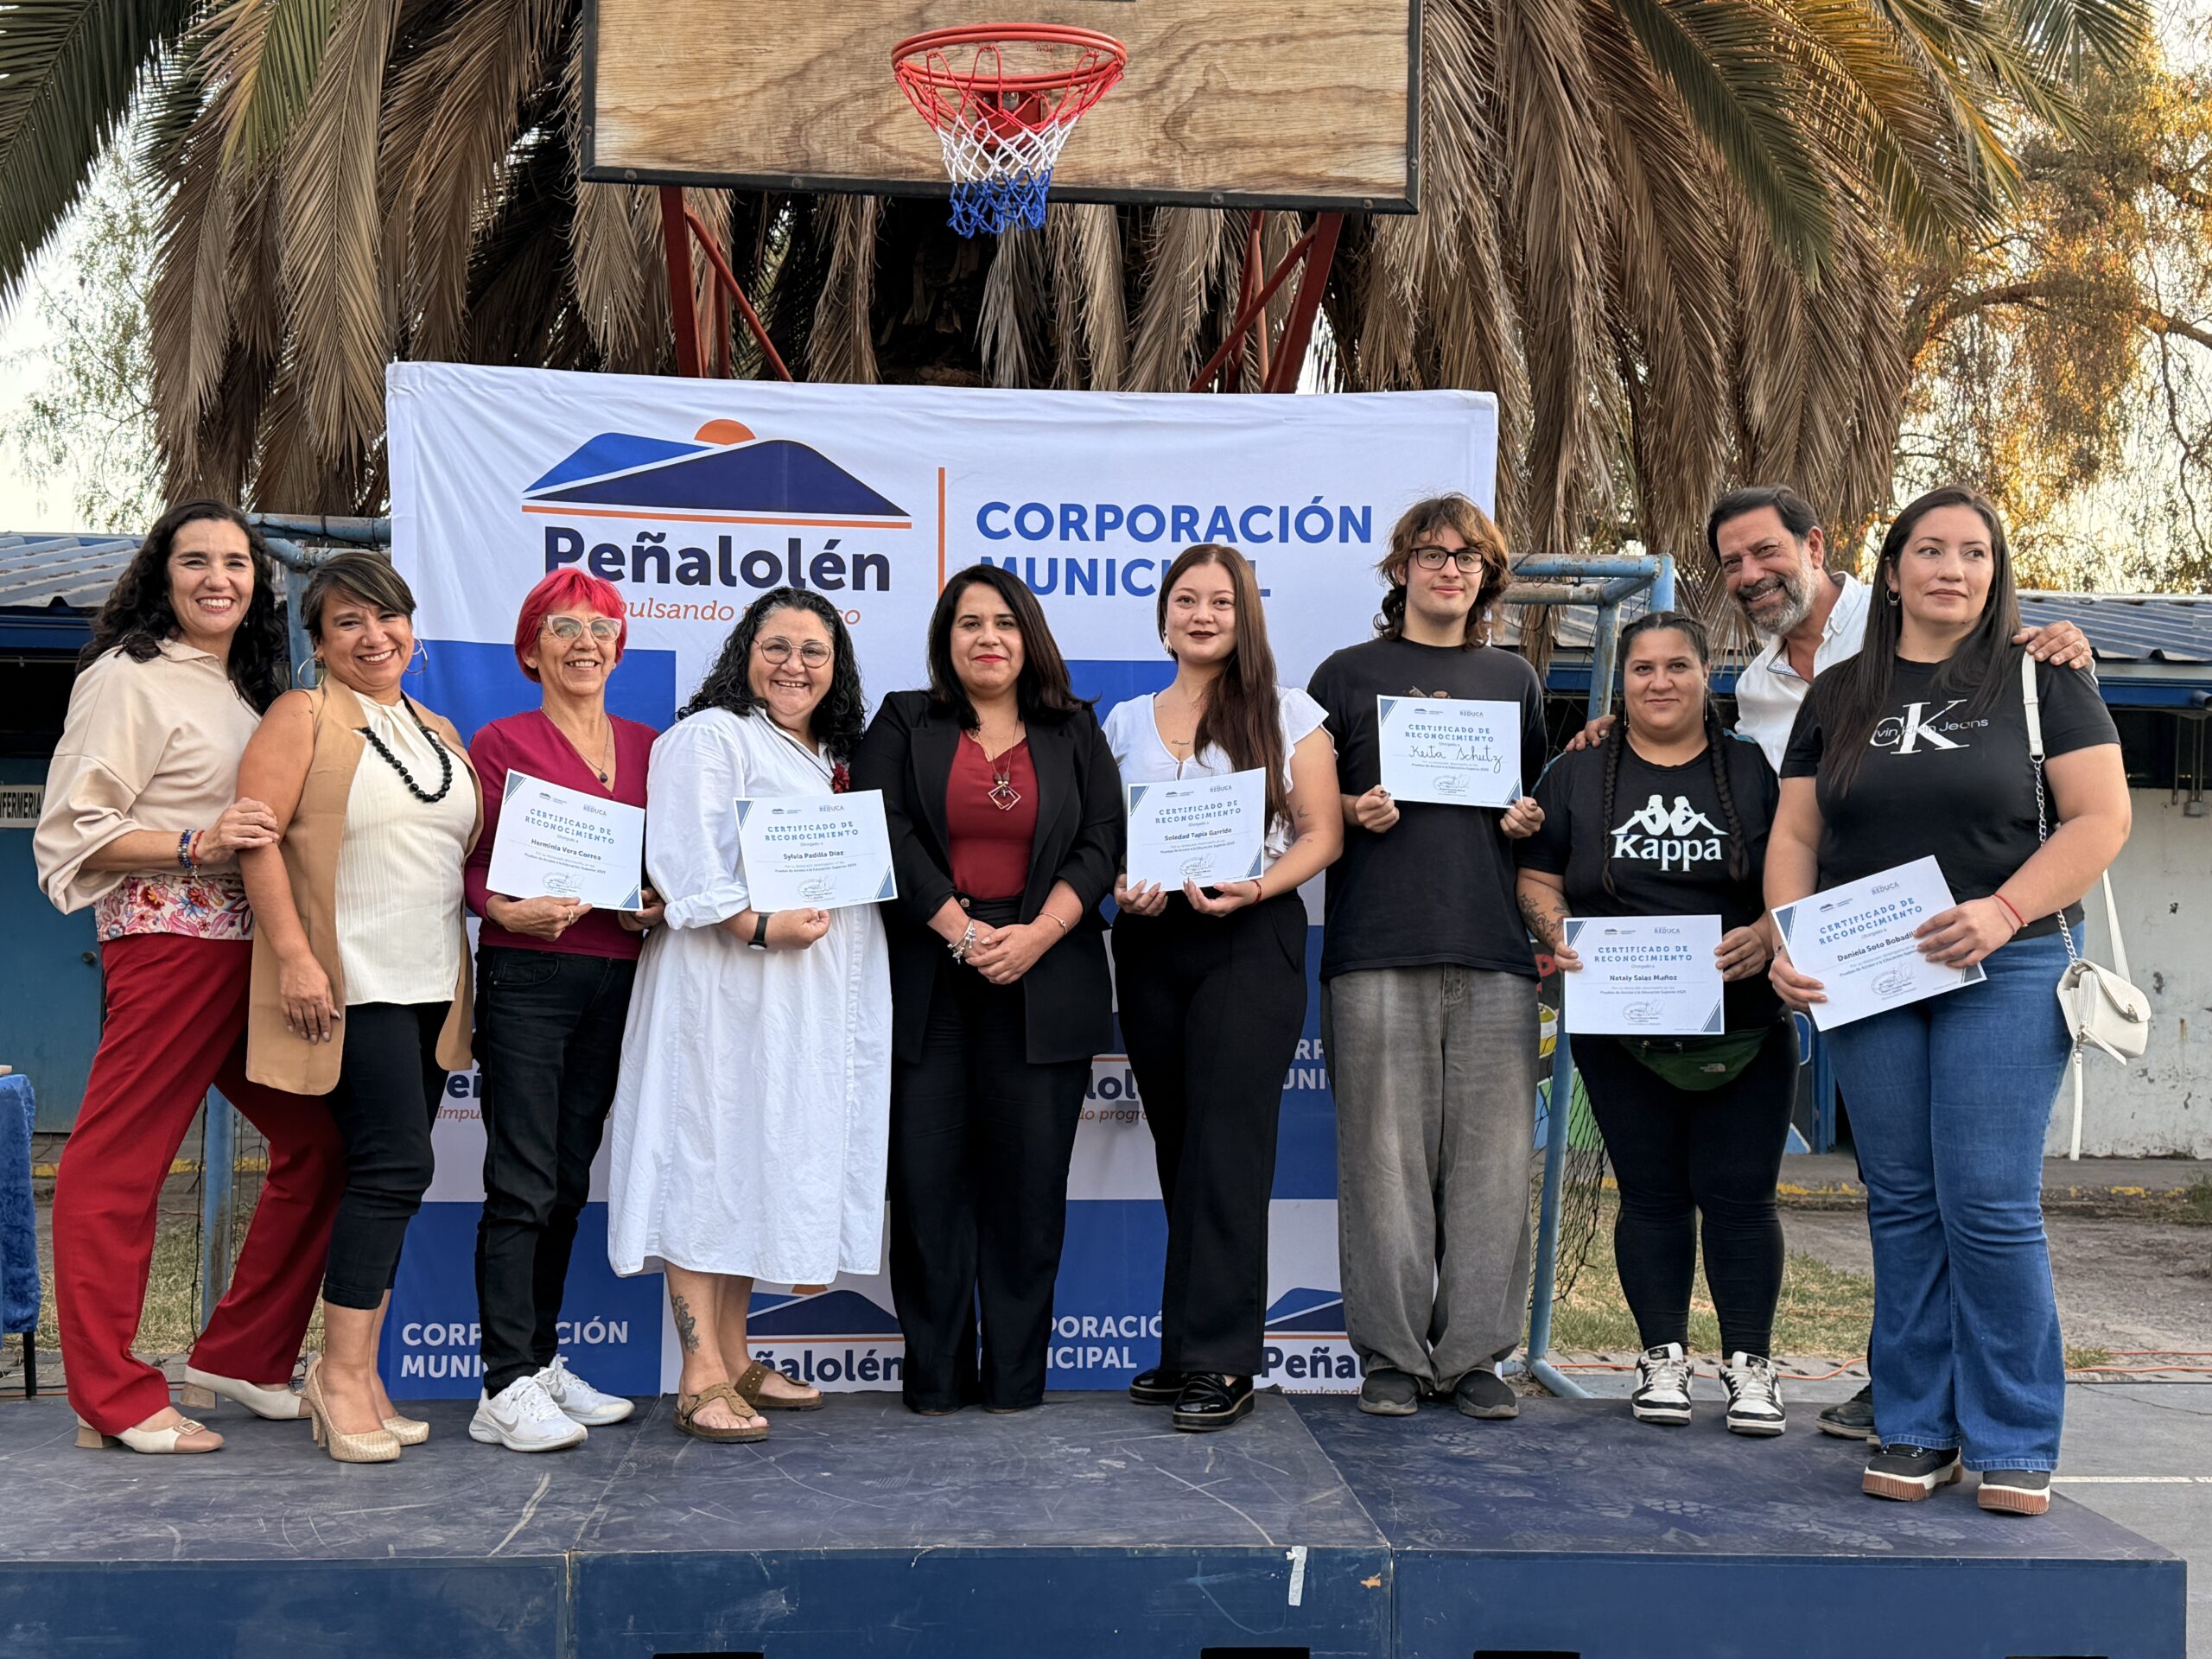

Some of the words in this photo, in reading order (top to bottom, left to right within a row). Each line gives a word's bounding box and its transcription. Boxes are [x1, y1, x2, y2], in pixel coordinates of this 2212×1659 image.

[402, 452, 628, 482] CORPCIÓN
[976, 496, 1372, 543] CORPORACIÓN
[545, 526, 890, 592] Peñalolén
[1405, 731, 1493, 741] RECONOCIMIENTO
[1408, 723, 1473, 733] CERTIFICADO
[1939, 719, 1989, 732] Jeans
[0, 791, 41, 819] FERMERIA
[1155, 807, 1241, 823] RECONOCIMIENTO
[1159, 802, 1222, 815] CERTIFICADO
[524, 816, 613, 843] RECONOCIMIENTO
[530, 808, 594, 830] CERTIFICADO
[599, 826, 611, 835] DE
[767, 823, 836, 832] CERTIFICADO
[1208, 827, 1231, 836] Garrido
[765, 829, 858, 841] RECONOCIMIENTO
[562, 846, 576, 855] Vera
[577, 850, 601, 860] Correa
[1612, 834, 1723, 872] Kappa
[1819, 906, 1921, 944] RECONOCIMIENTO
[1820, 904, 1895, 933] CERTIFICADO
[1899, 897, 1914, 906] DE
[1837, 948, 1866, 961] Daniela
[1866, 942, 1885, 951] Soto
[1885, 931, 1918, 945] Bobadil
[1047, 1346, 1137, 1369] ICIPAL
